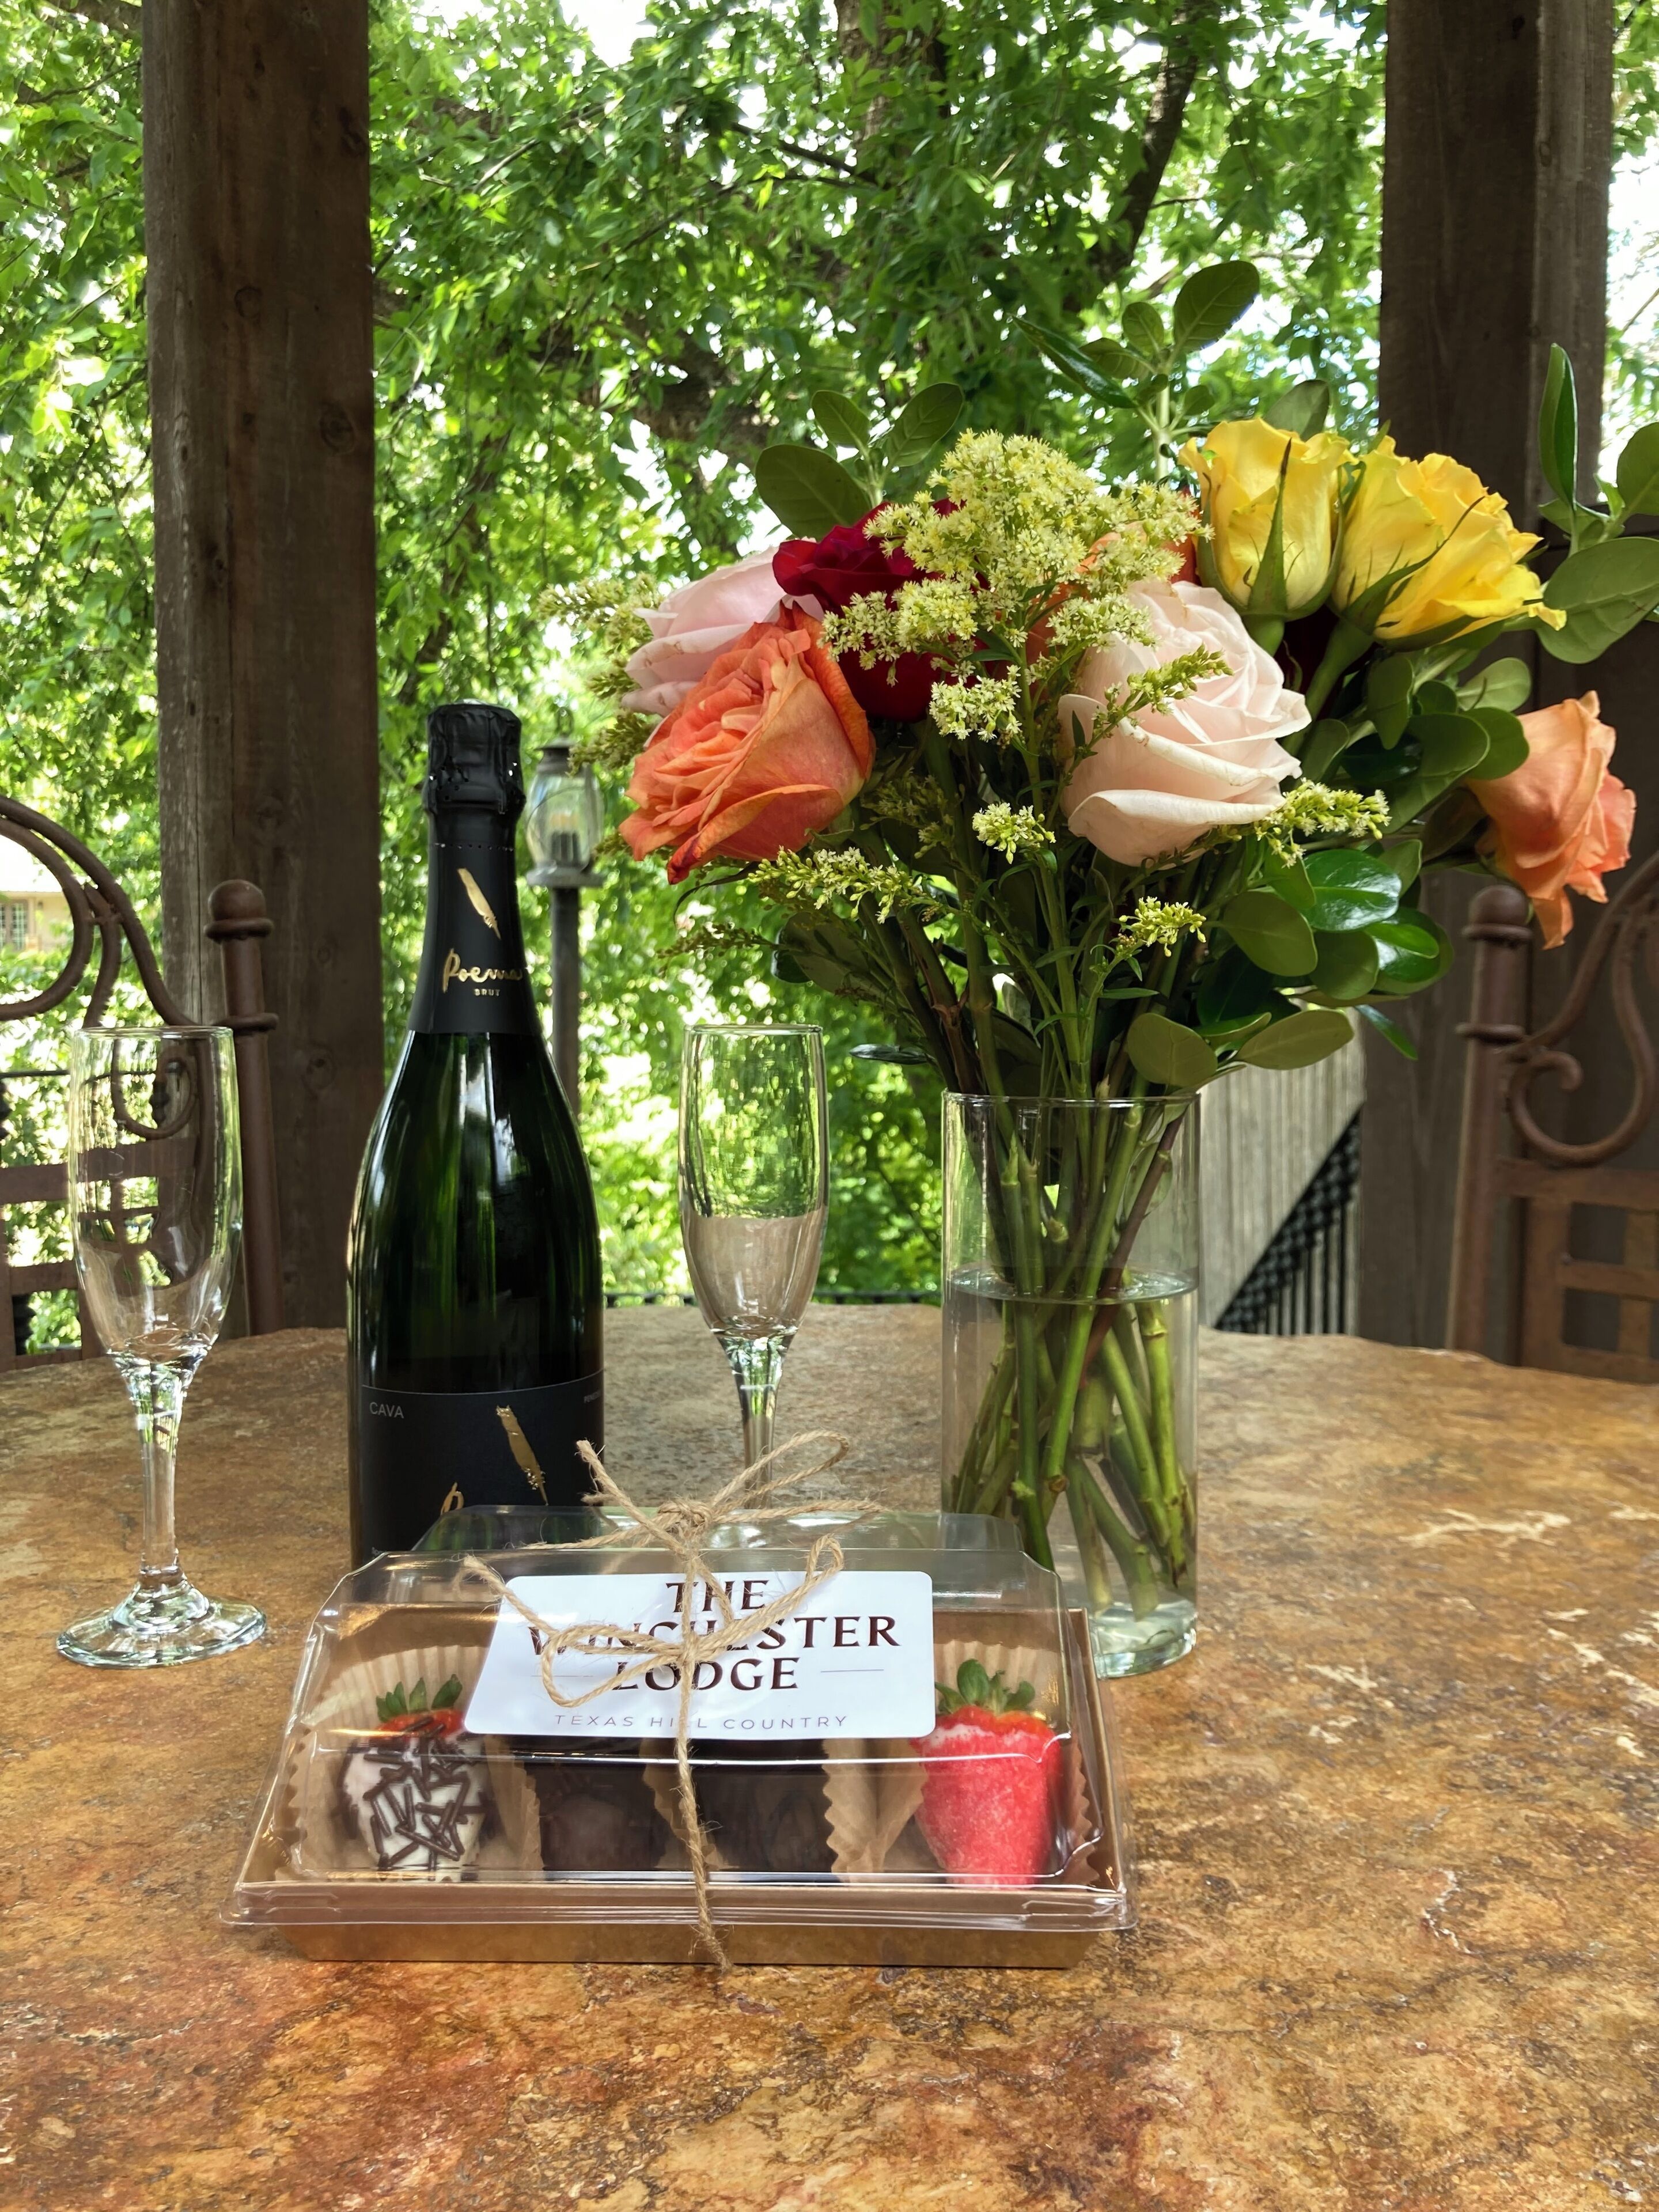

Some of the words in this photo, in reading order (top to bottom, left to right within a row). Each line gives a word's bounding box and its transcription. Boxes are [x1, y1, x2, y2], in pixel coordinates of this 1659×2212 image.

[442, 948, 522, 993] Poema
[370, 1402, 404, 1419] CAVA
[666, 1580, 770, 1613] THE
[527, 1616, 902, 1655] WCHSTER
[612, 1657, 800, 1691] LODGE
[555, 1715, 634, 1727] TEXAS
[650, 1717, 707, 1728] HIL
[724, 1715, 847, 1729] COUNTRY
